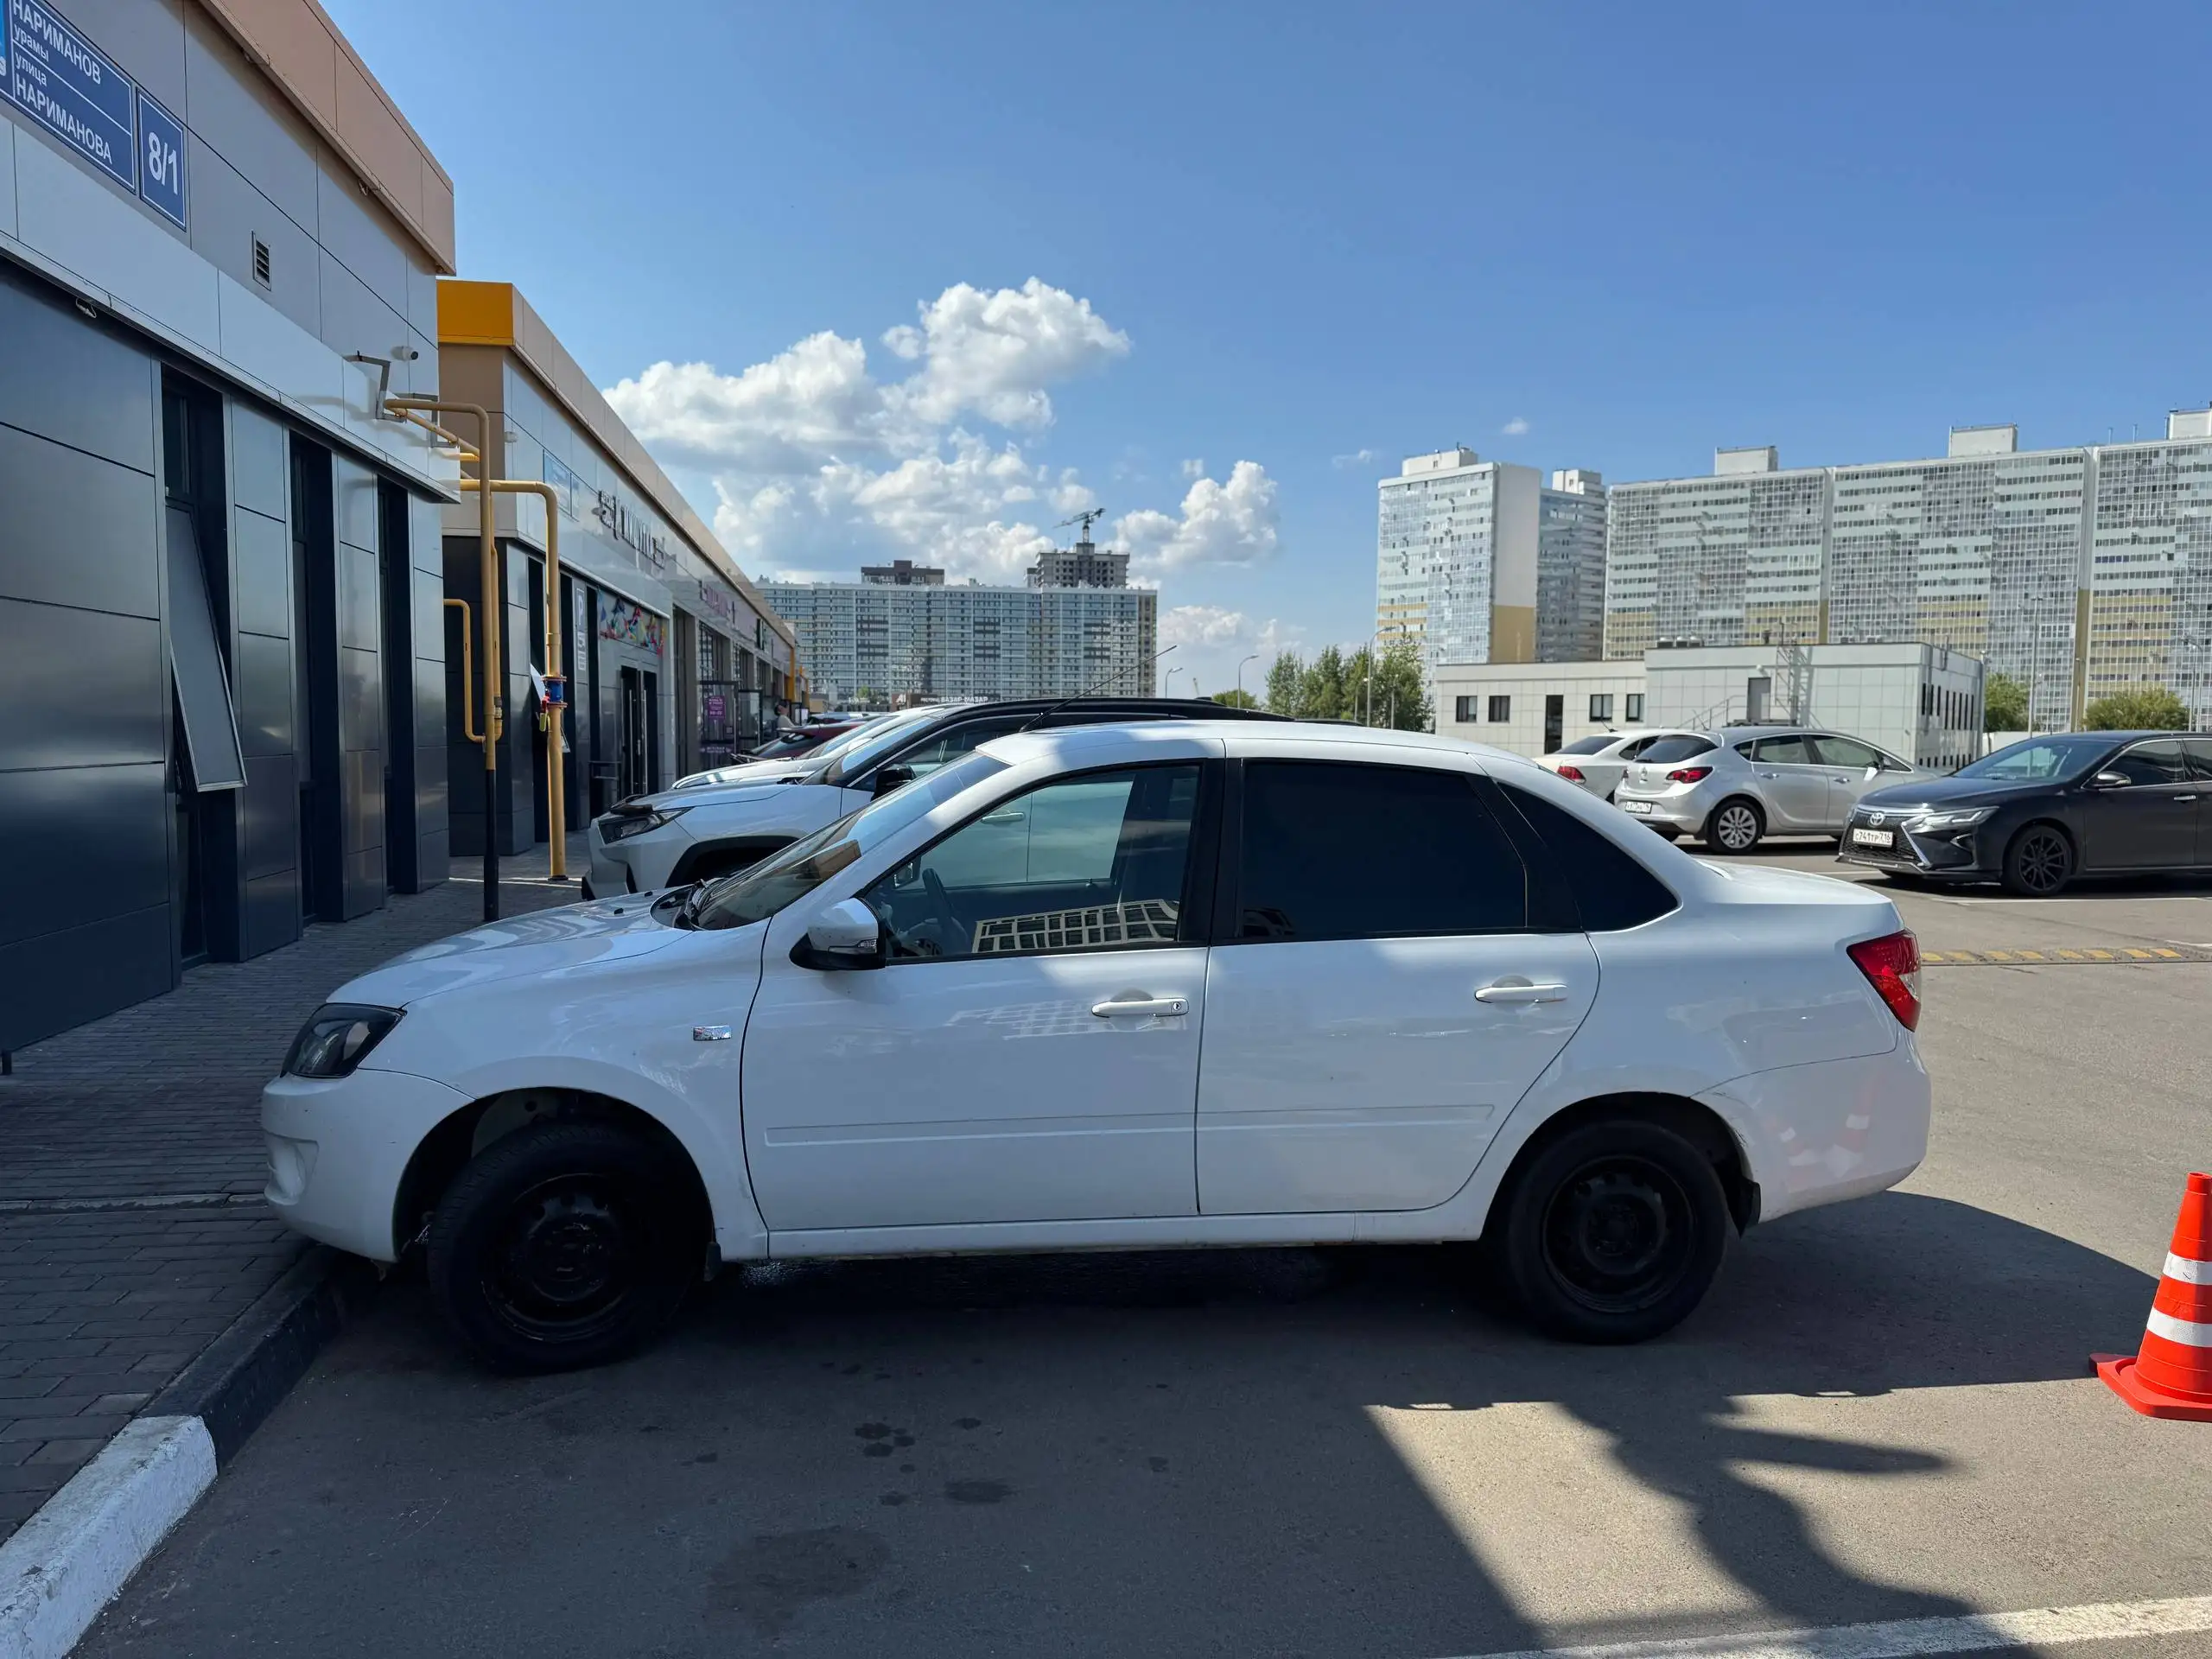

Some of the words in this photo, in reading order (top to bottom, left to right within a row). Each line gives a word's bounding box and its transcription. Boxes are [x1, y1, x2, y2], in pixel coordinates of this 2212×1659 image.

[14, 0, 101, 85] НАРИМАНОВ
[14, 24, 49, 62] урамы
[16, 52, 47, 86] улица
[16, 73, 113, 164] НАРИМАНОВА
[148, 131, 179, 195] 8/1
